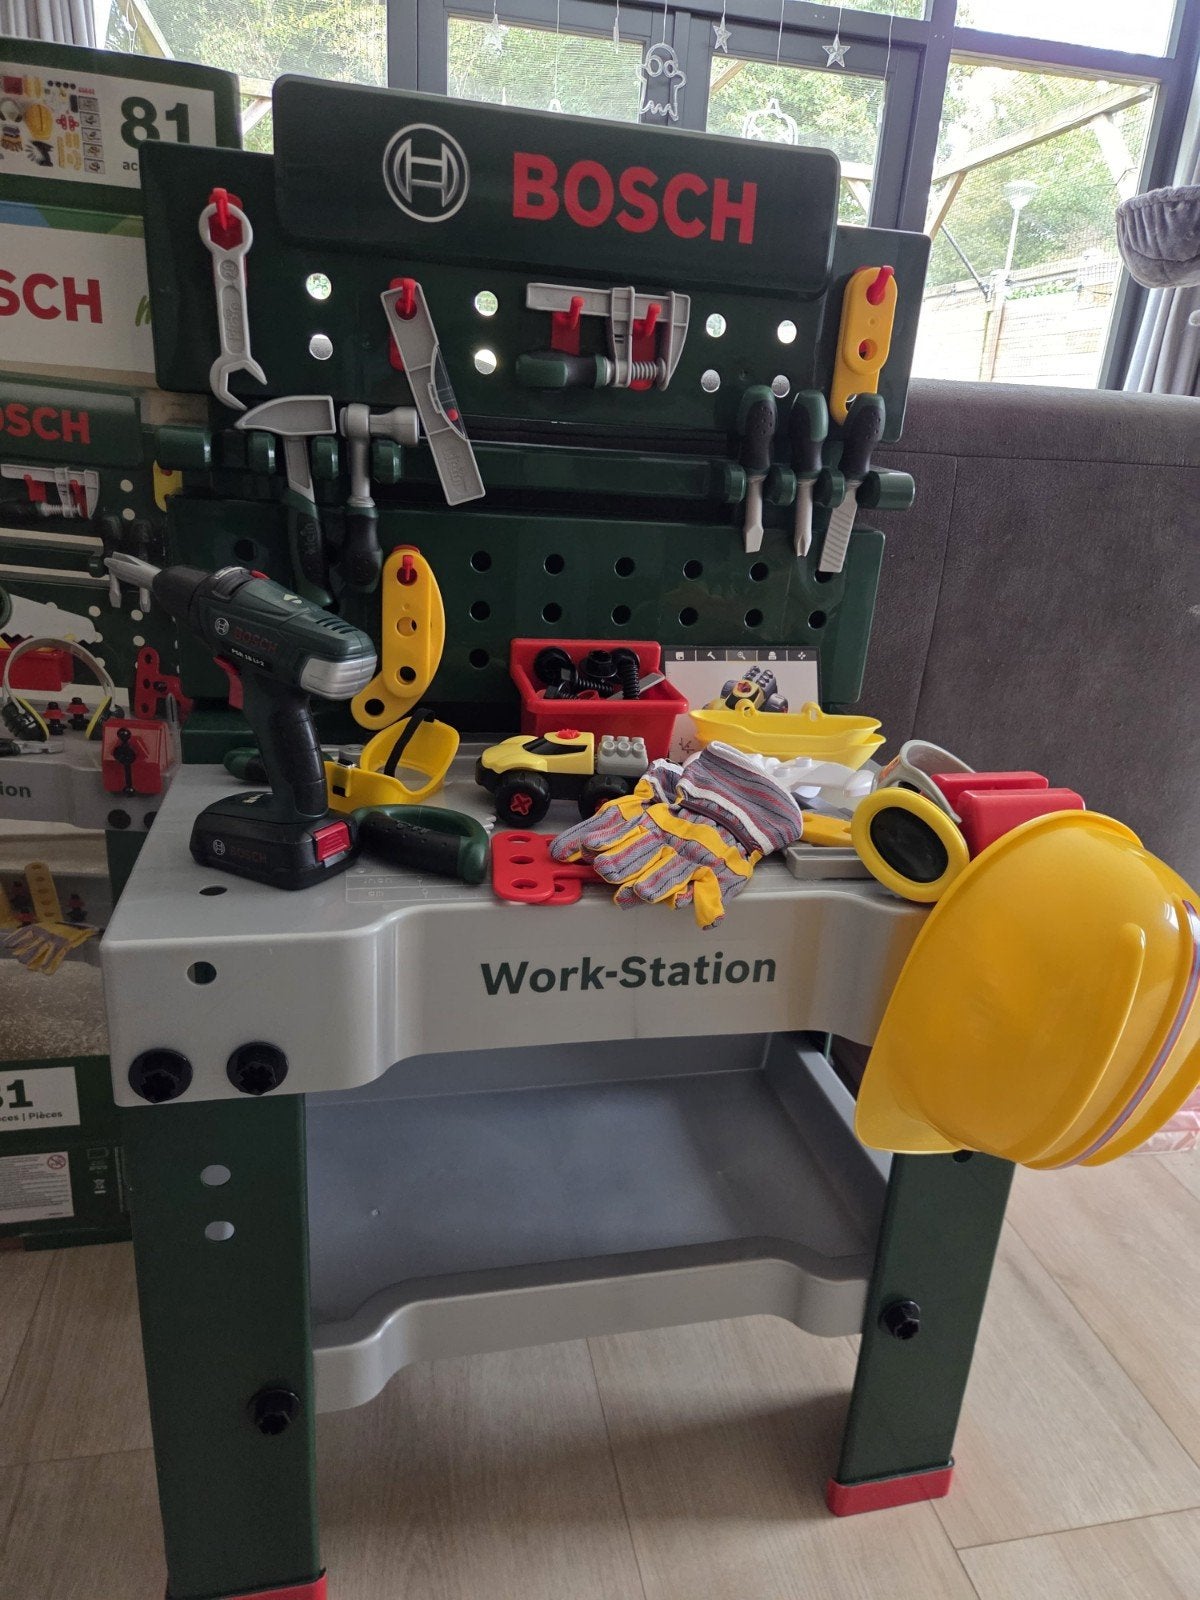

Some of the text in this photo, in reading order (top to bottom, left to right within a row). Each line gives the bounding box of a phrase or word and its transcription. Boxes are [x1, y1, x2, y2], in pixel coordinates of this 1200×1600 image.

[121, 96, 190, 149] 81
[513, 152, 757, 244] BOSCH
[0, 403, 91, 445] SCH
[234, 626, 279, 652] BOSCH
[480, 951, 777, 996] Work-Station
[0, 1079, 33, 1109] 1
[0, 1113, 19, 1122] ces
